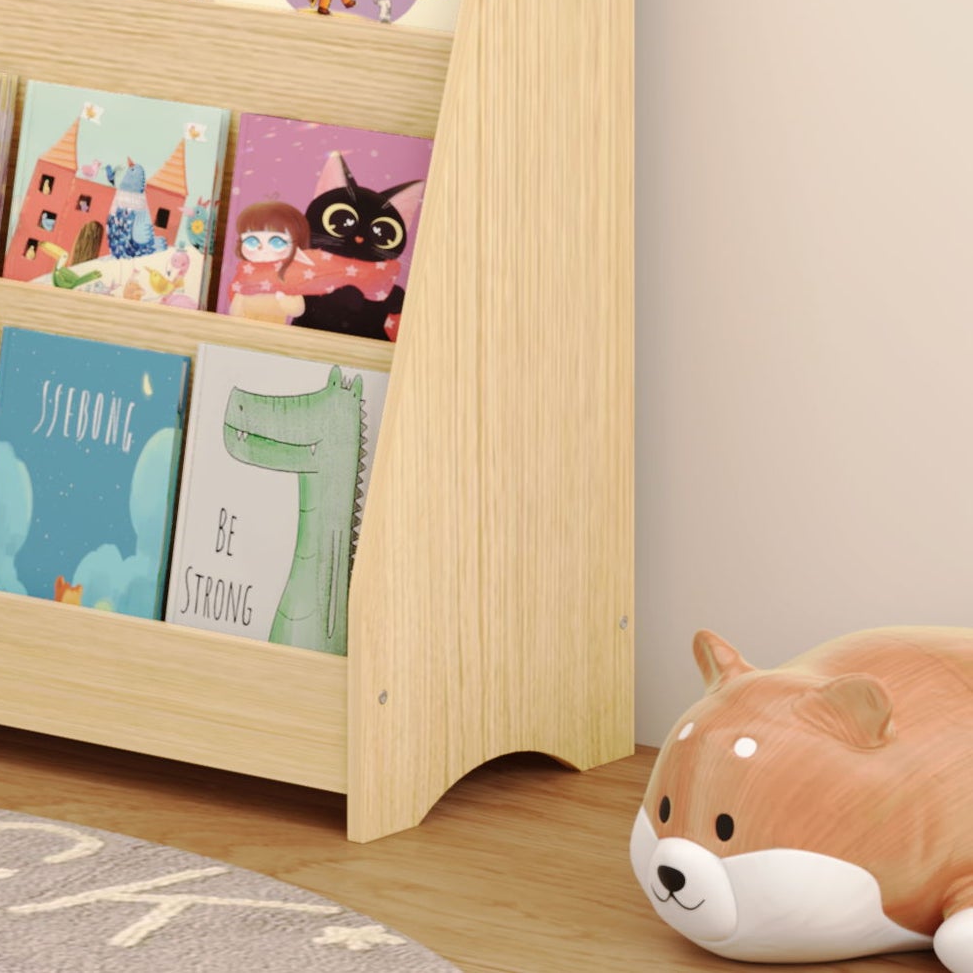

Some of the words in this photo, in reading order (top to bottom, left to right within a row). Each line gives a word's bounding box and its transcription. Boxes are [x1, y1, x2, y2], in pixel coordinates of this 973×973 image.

[32, 379, 135, 454] SSEBONG
[215, 507, 238, 557] BE
[180, 565, 253, 627] STRONG
